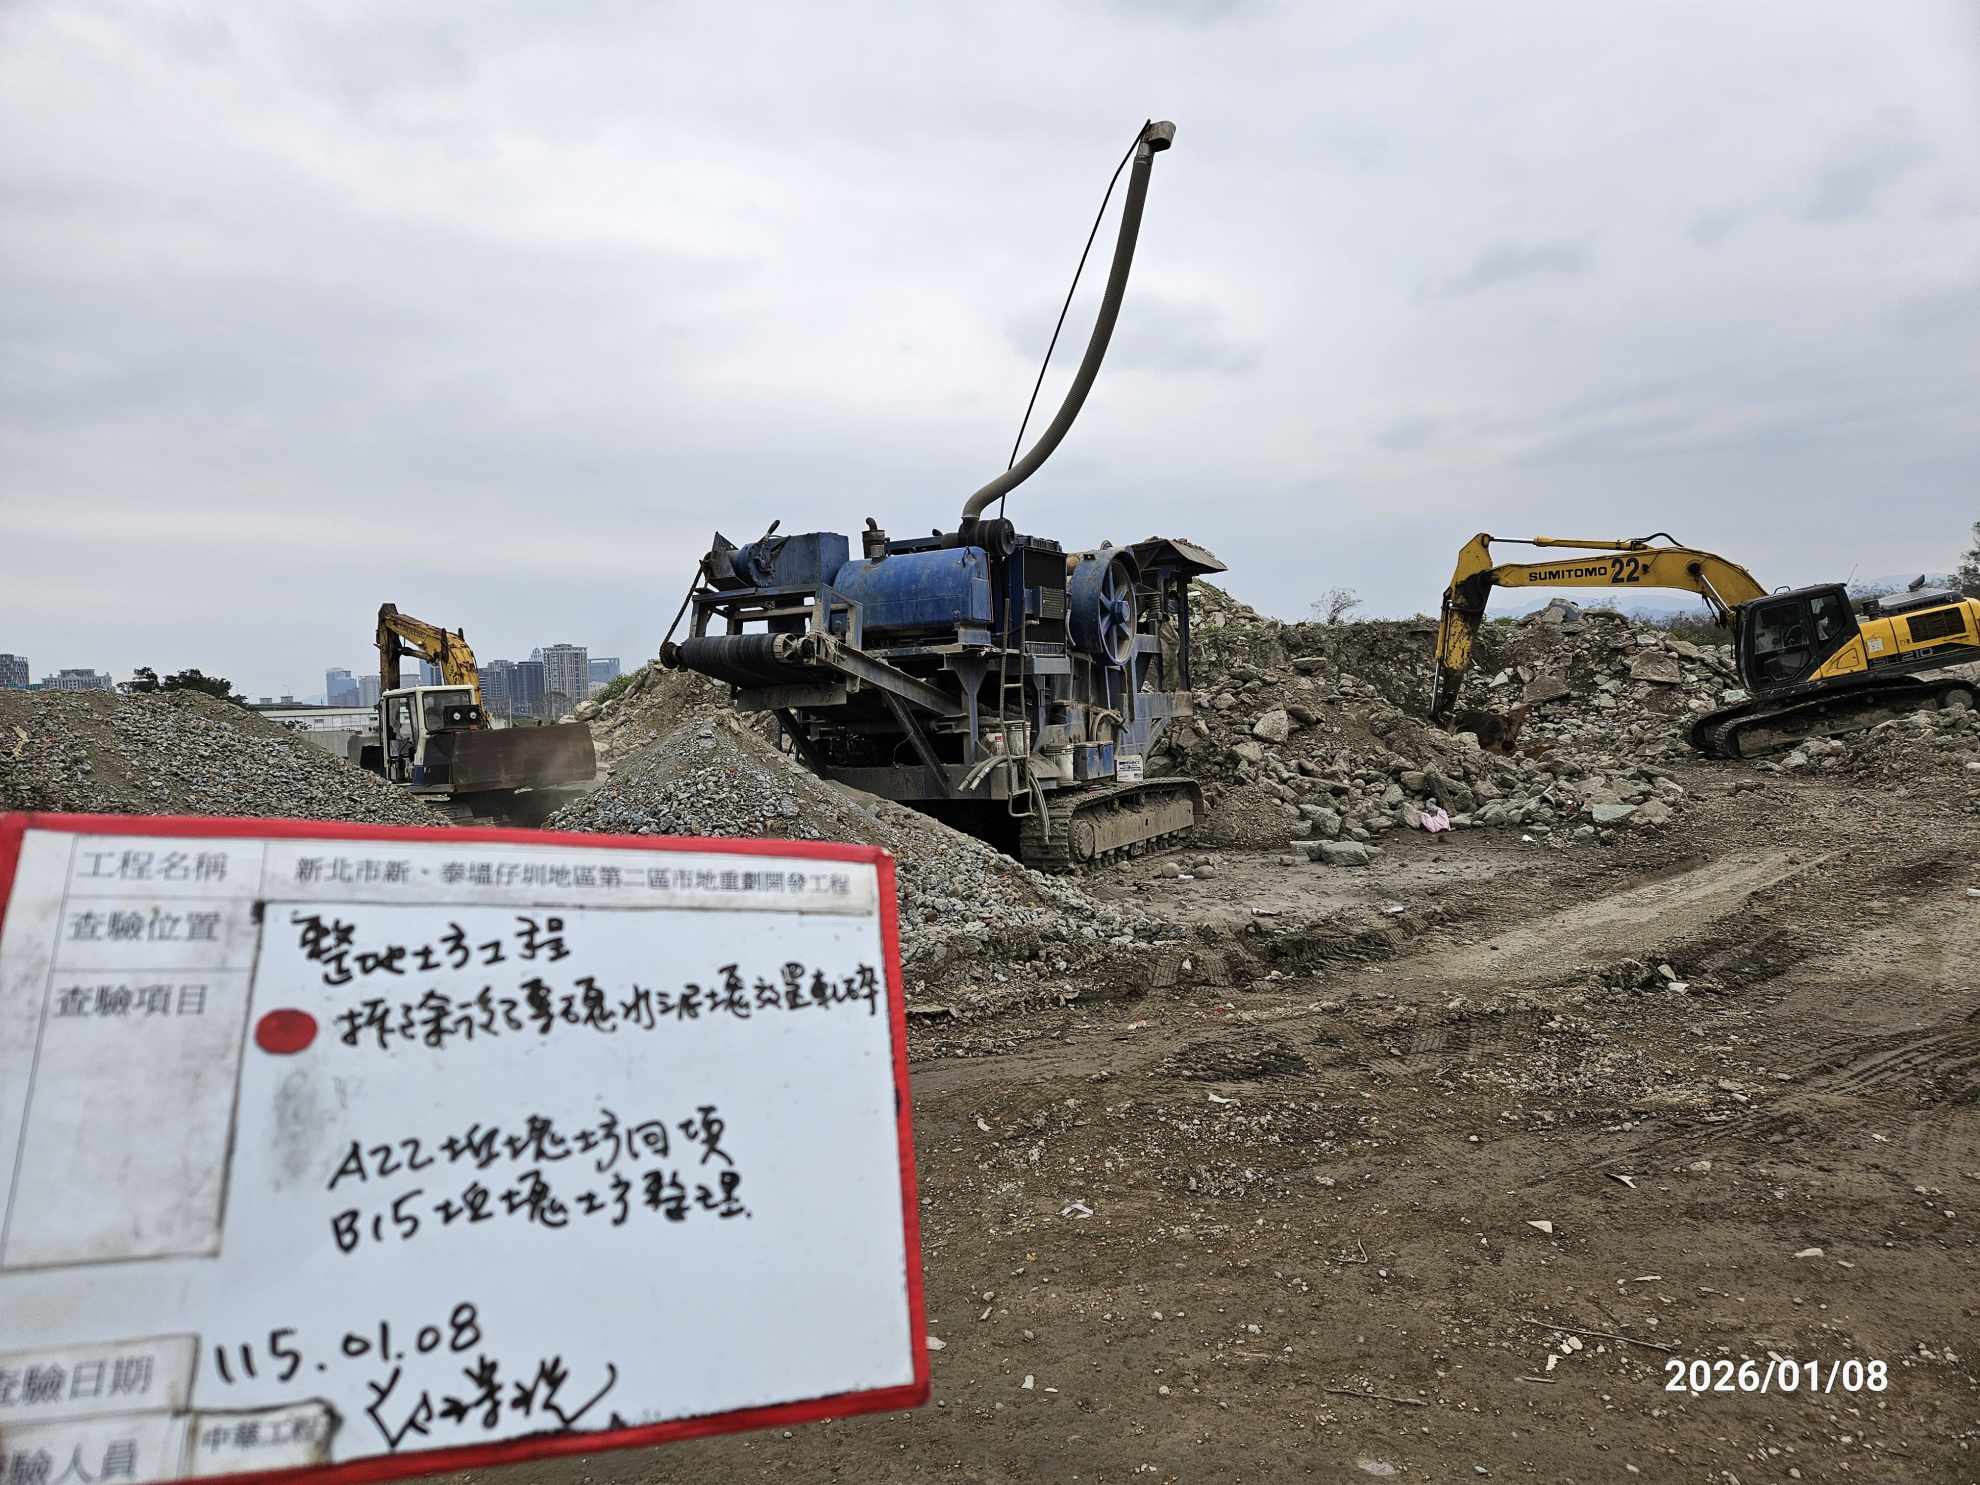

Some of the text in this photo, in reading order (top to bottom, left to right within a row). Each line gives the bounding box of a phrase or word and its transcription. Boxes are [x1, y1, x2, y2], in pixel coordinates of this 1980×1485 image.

[1528, 557, 1640, 584] SUMITOMO 22
[77, 850, 228, 882] 工程名稱
[68, 908, 221, 942] 查驗位置
[53, 984, 208, 1018] 查驗項目
[214, 1303, 482, 1384] 115.01.08
